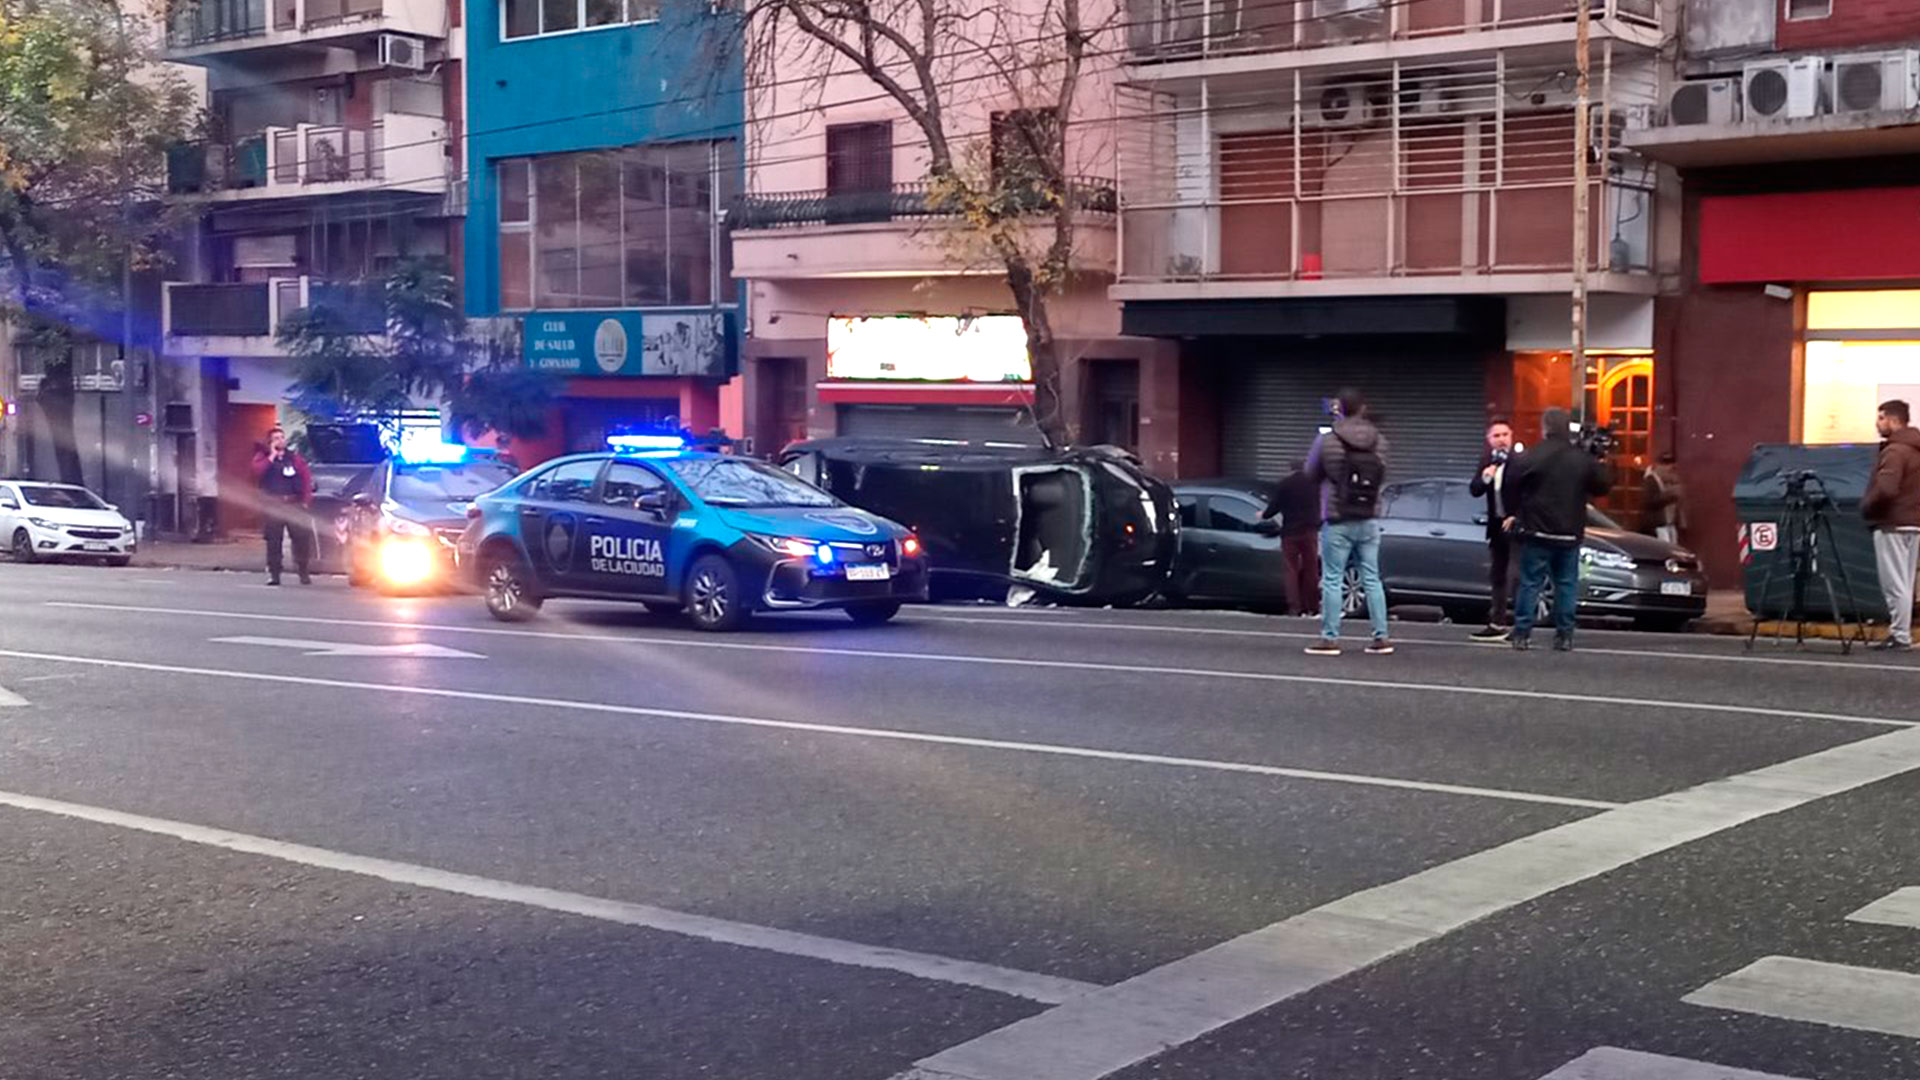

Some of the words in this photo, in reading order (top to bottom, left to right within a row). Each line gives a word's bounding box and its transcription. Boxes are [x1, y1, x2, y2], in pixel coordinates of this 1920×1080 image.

[543, 321, 566, 332] CLUB
[591, 535, 664, 562] POLICIA
[591, 558, 608, 571] DE
[608, 560, 623, 573] LA
[623, 560, 665, 577] CIUDAD
